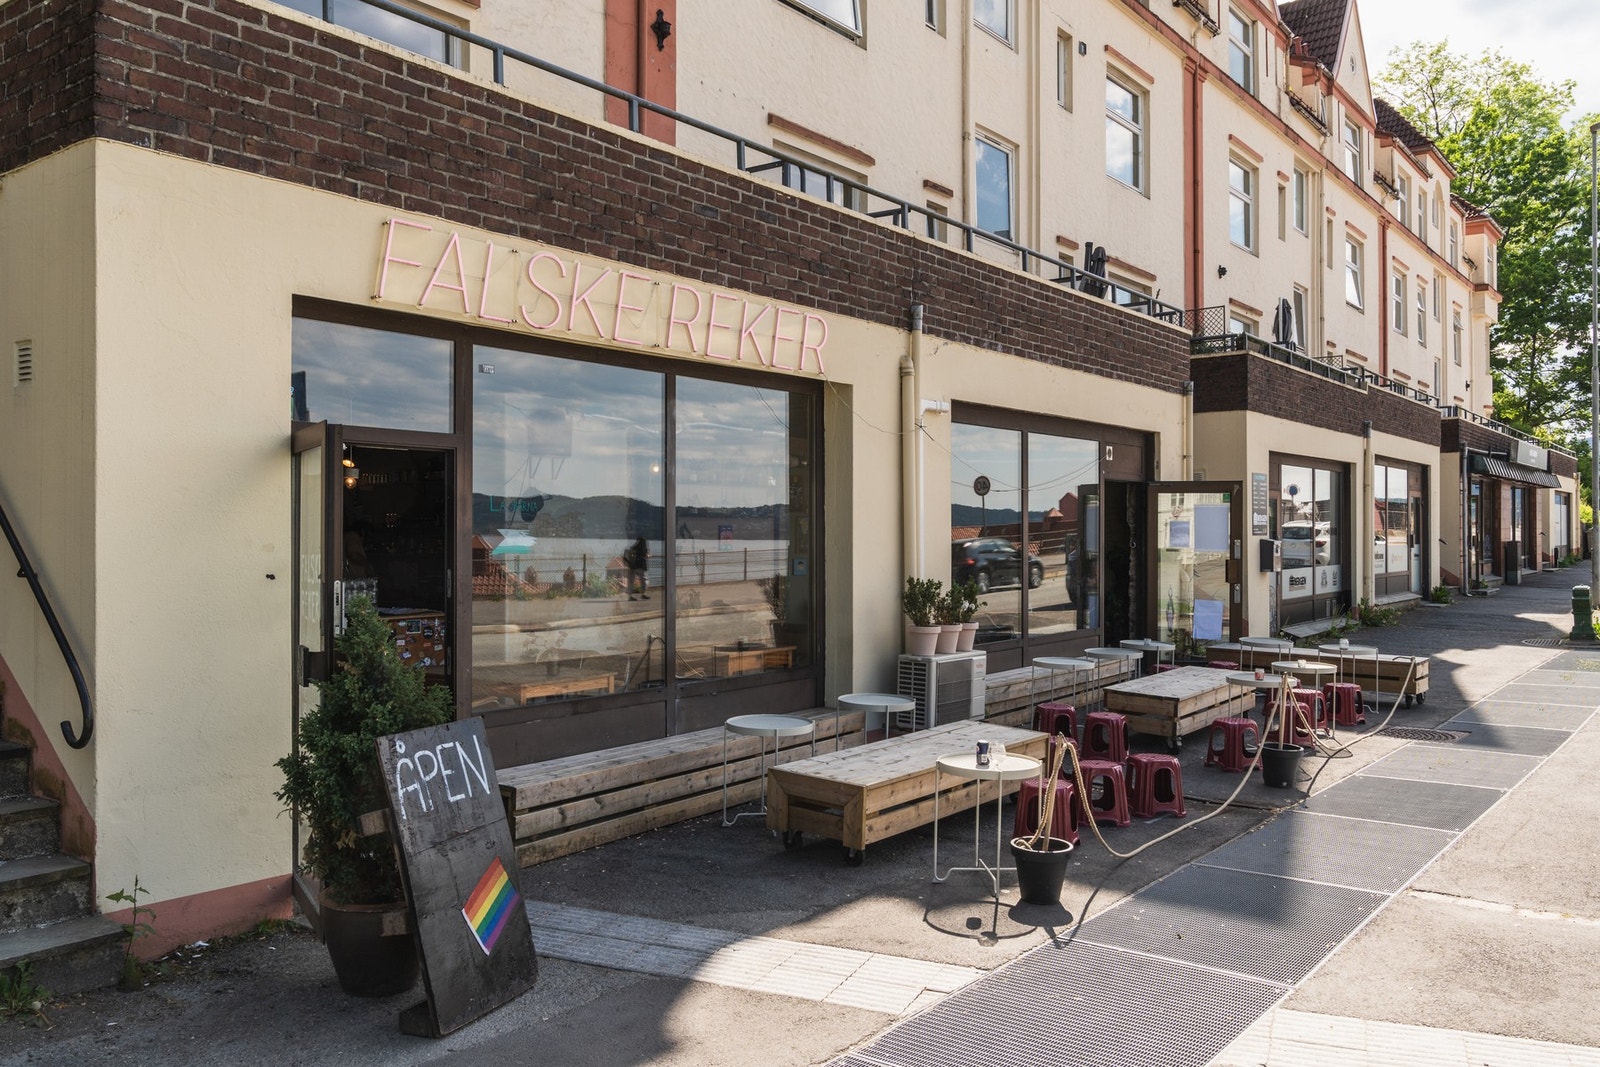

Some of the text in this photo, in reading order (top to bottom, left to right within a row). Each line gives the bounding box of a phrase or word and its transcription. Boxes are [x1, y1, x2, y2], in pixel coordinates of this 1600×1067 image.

[378, 217, 829, 375] FALSKE REKER
[395, 734, 492, 820] ÅPEN
